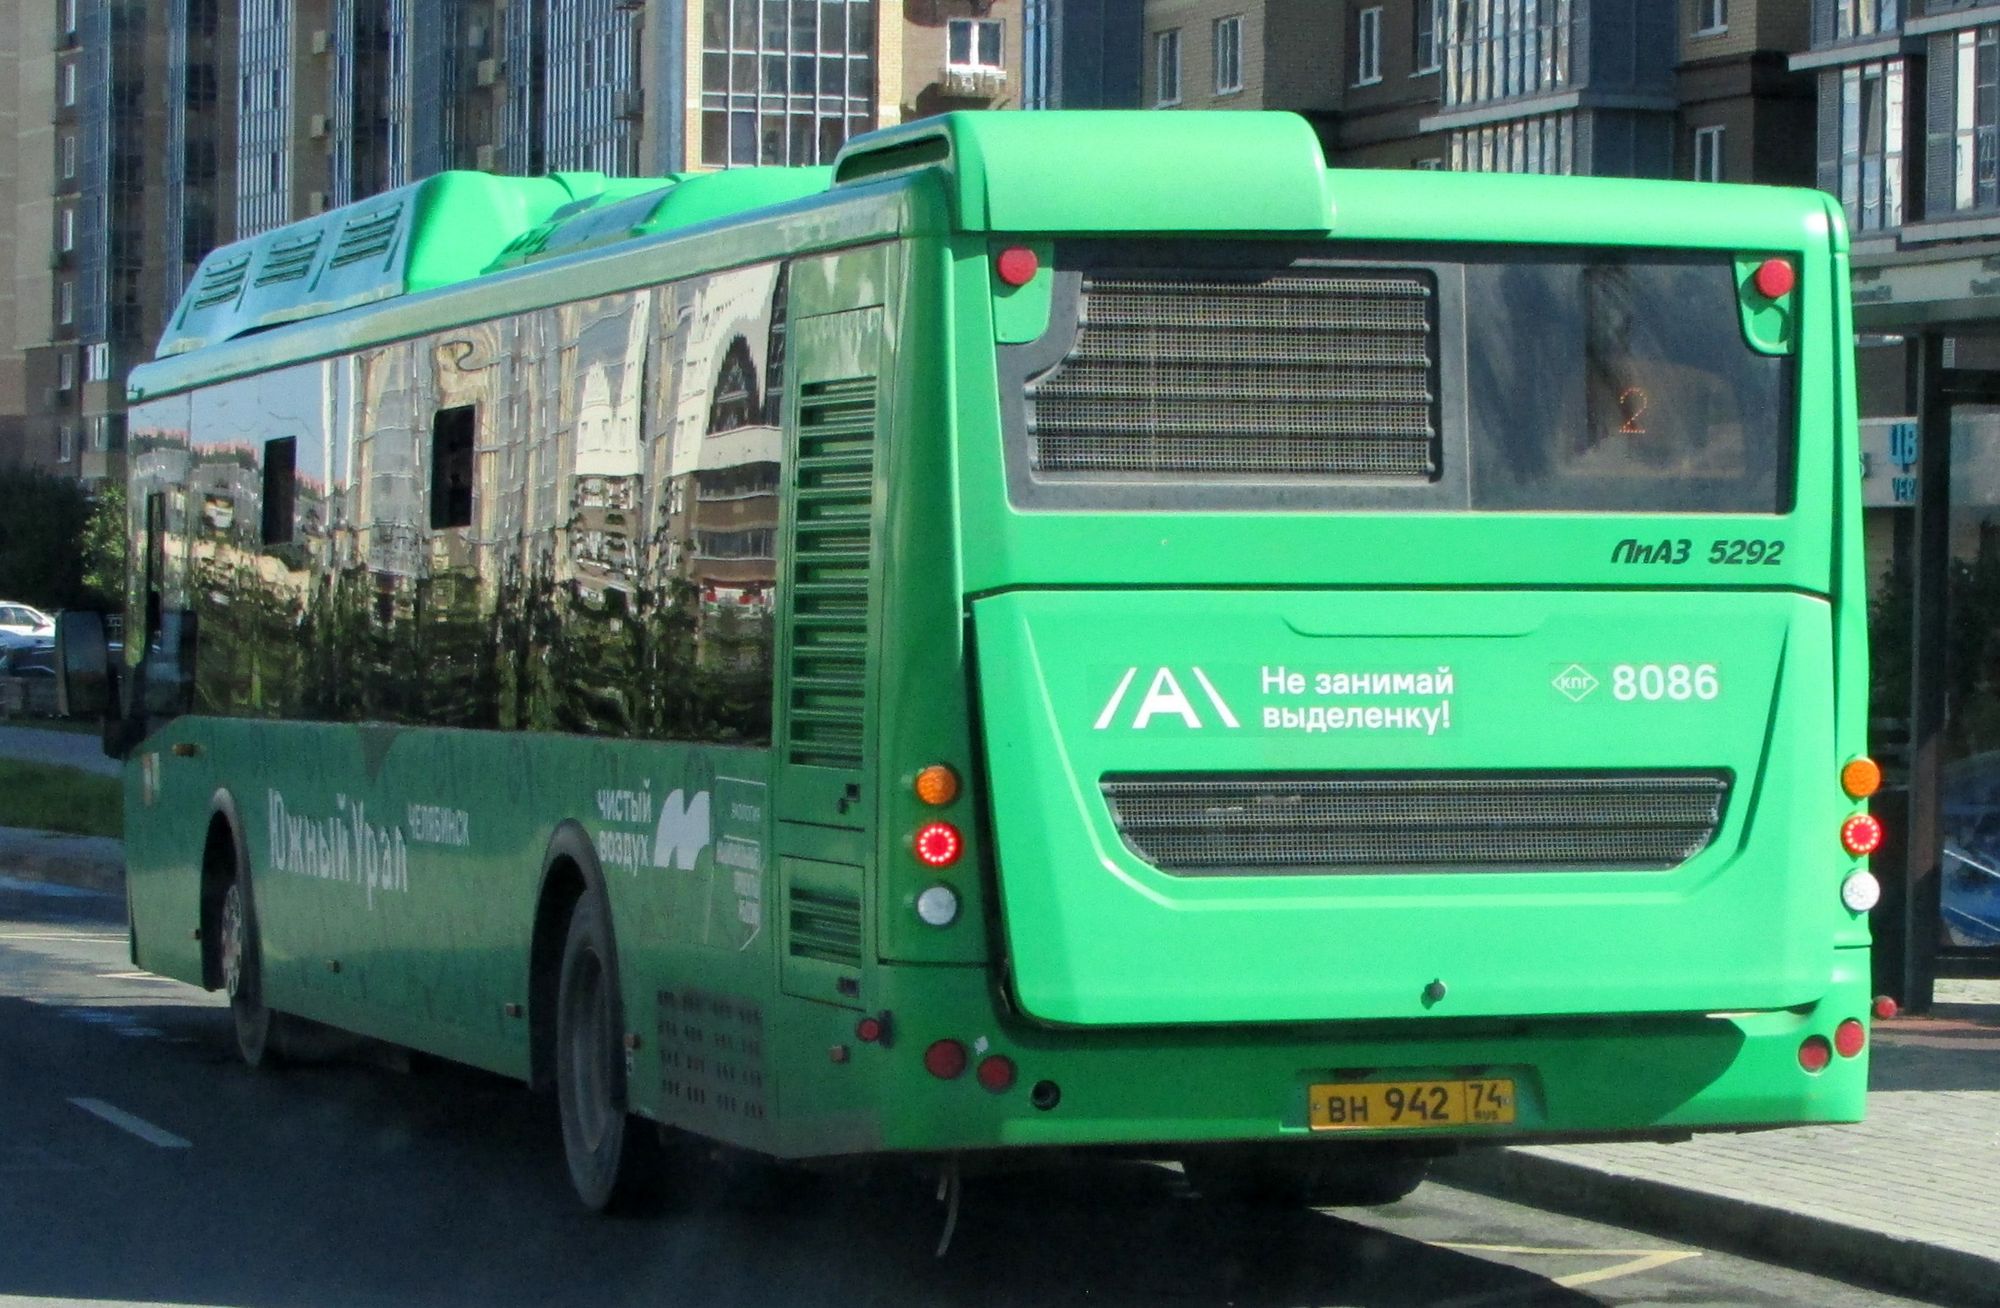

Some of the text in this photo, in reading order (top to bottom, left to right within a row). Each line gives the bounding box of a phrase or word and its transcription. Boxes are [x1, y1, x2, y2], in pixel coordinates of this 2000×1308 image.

[1618, 386, 1649, 435] 2
[1708, 540, 1786, 566] 5292
[1261, 665, 1454, 695] Не занимай
[1613, 664, 1720, 701] 8086
[1262, 699, 1452, 736] выделенку!
[268, 788, 408, 911] Южный Урал
[1385, 1086, 1450, 1121] 942
[1470, 1083, 1503, 1109] 74
